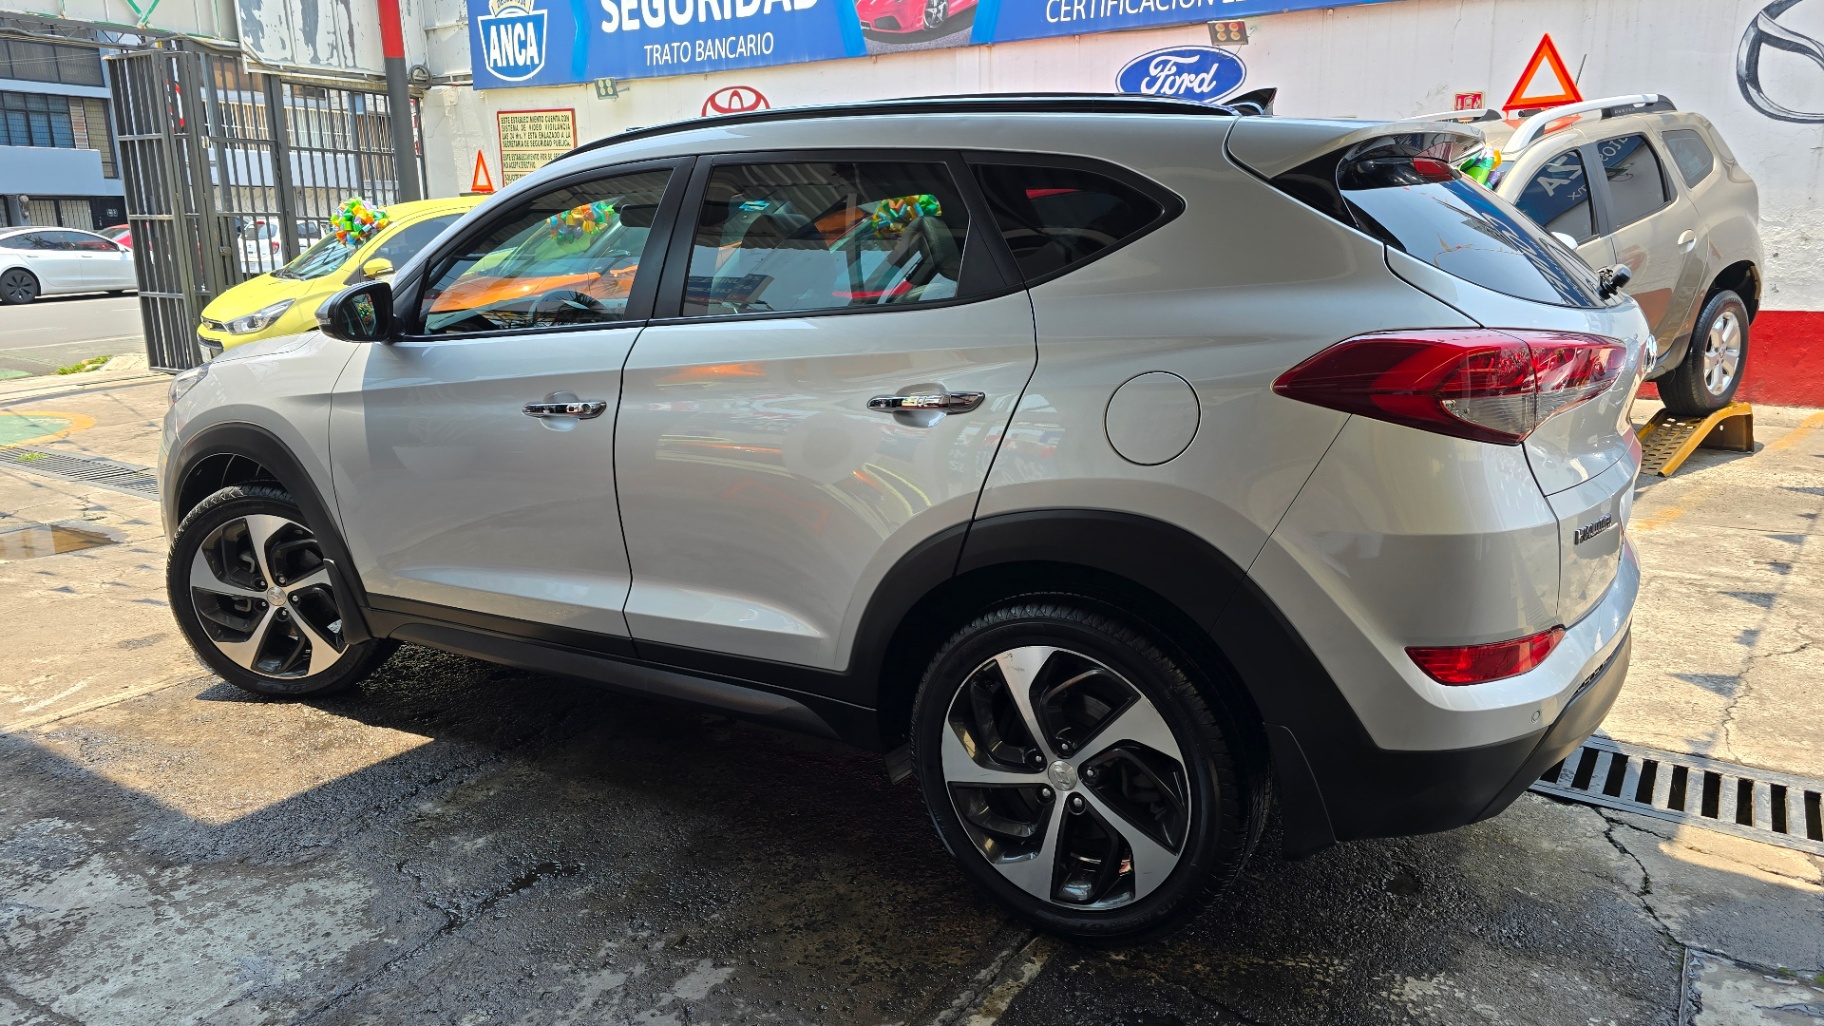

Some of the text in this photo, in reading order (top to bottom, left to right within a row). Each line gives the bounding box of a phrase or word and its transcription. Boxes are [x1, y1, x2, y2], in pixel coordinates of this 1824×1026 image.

[490, 22, 539, 67] ANCA
[643, 32, 774, 66] TRATO BANCARIO
[1140, 54, 1219, 95] Ford
